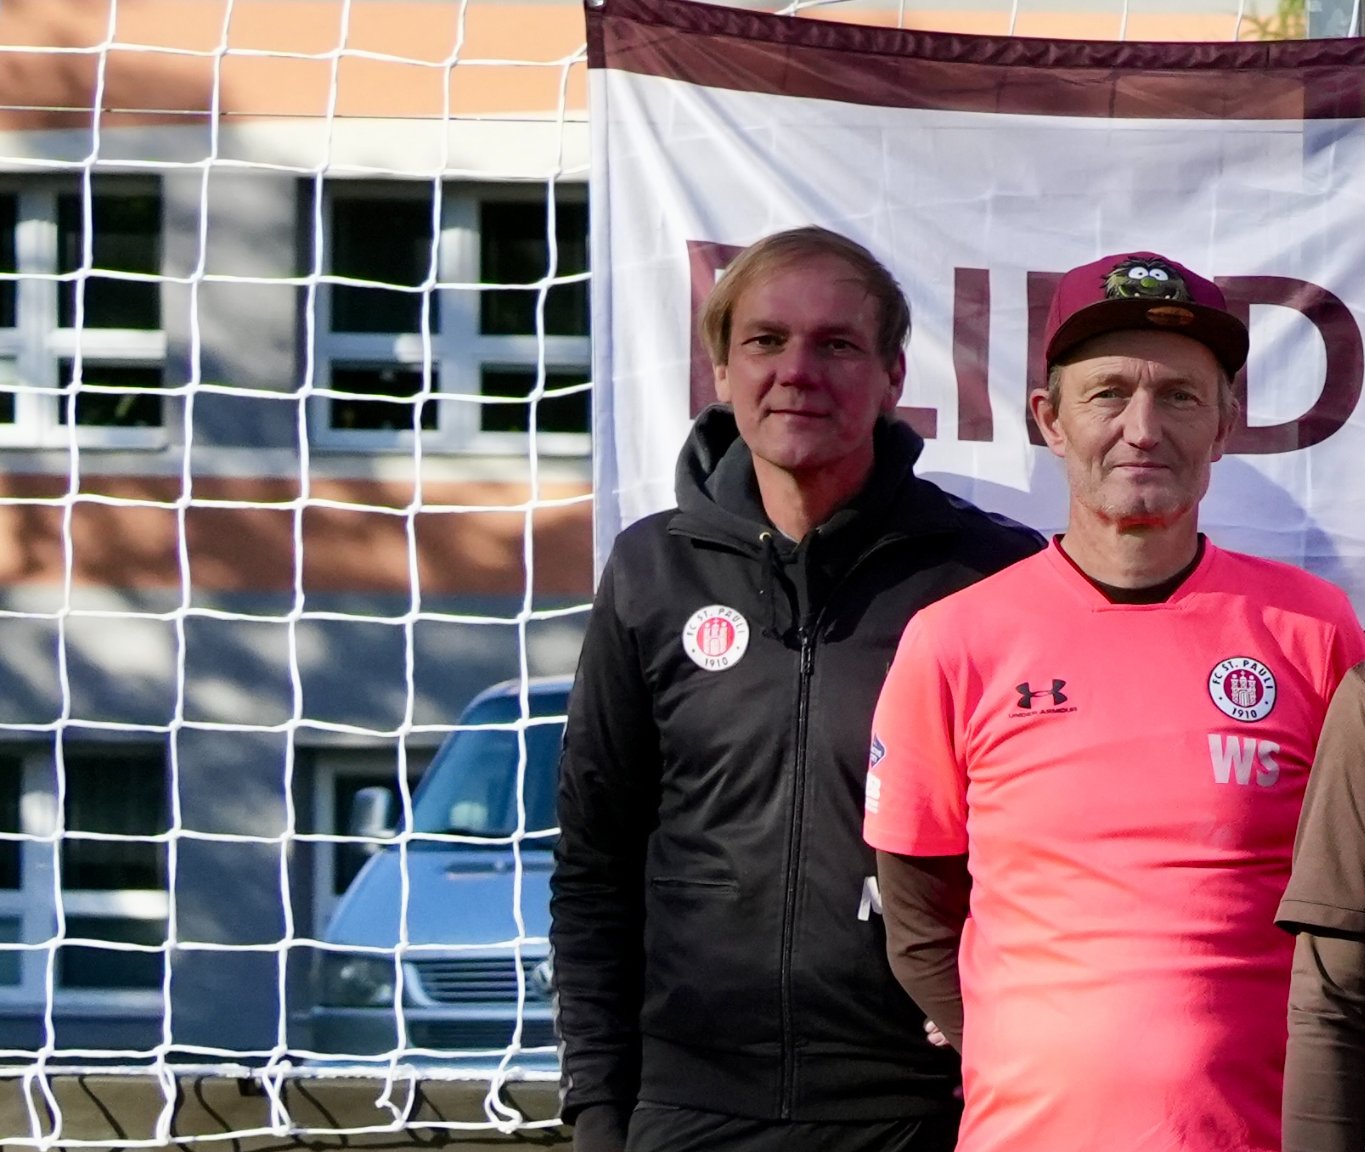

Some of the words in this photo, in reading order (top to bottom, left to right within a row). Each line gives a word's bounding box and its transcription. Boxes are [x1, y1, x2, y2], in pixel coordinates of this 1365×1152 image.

[687, 622, 698, 637] FC
[718, 607, 746, 635] PAULI
[704, 656, 729, 668] 1910
[1211, 671, 1224, 687] FC
[1222, 659, 1239, 672] ST.
[1242, 659, 1274, 690] PAULI
[1231, 707, 1258, 719] 1910
[1207, 733, 1281, 788] WS
